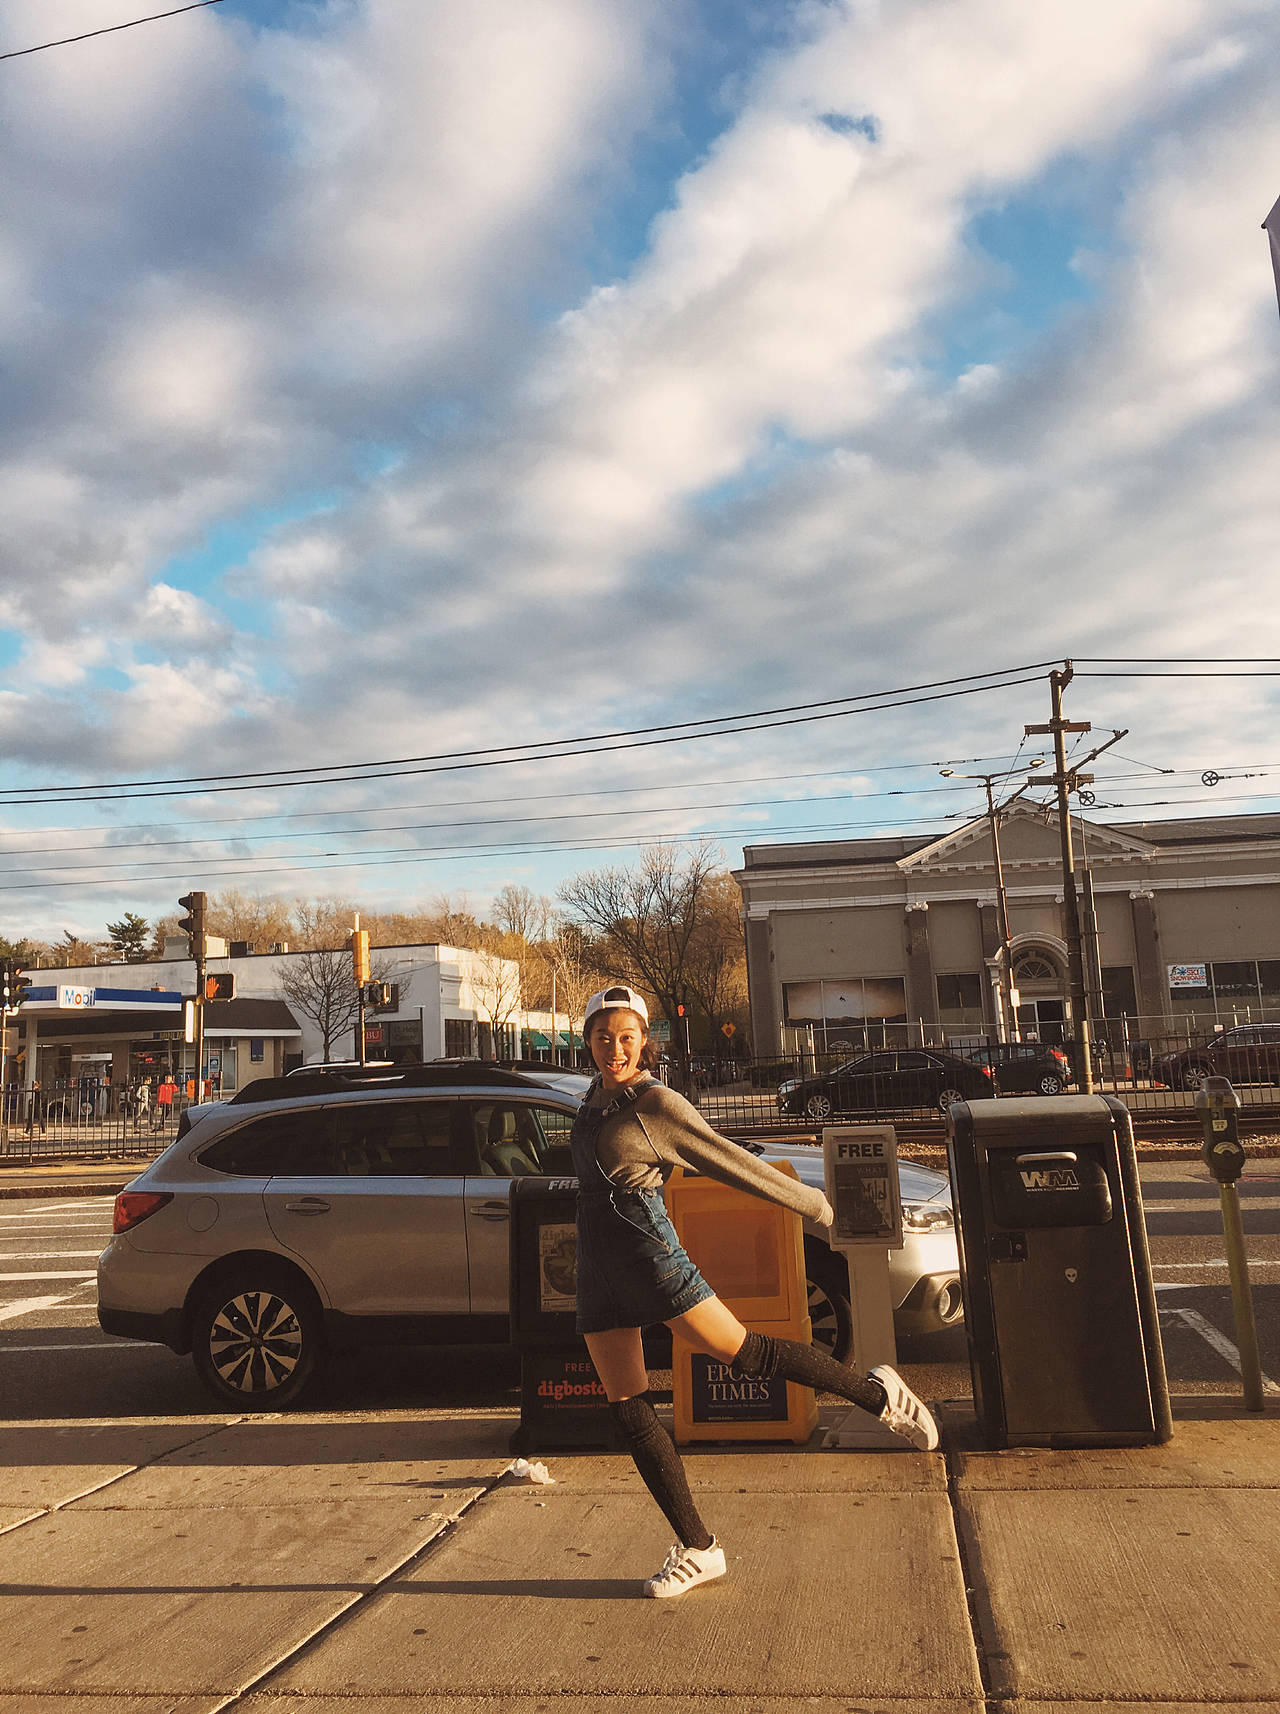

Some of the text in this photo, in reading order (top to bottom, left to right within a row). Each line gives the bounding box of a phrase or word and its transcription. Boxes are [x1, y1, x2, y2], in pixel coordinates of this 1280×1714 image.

[65, 989, 97, 1006] Mobil
[366, 1031, 380, 1040] BU
[838, 1143, 884, 1158] FREE
[548, 1179, 580, 1191] FRE
[1020, 1169, 1080, 1188] WM
[565, 1363, 591, 1372] FREE
[538, 1380, 607, 1400] digbosto
[707, 1382, 770, 1401] TIMES
